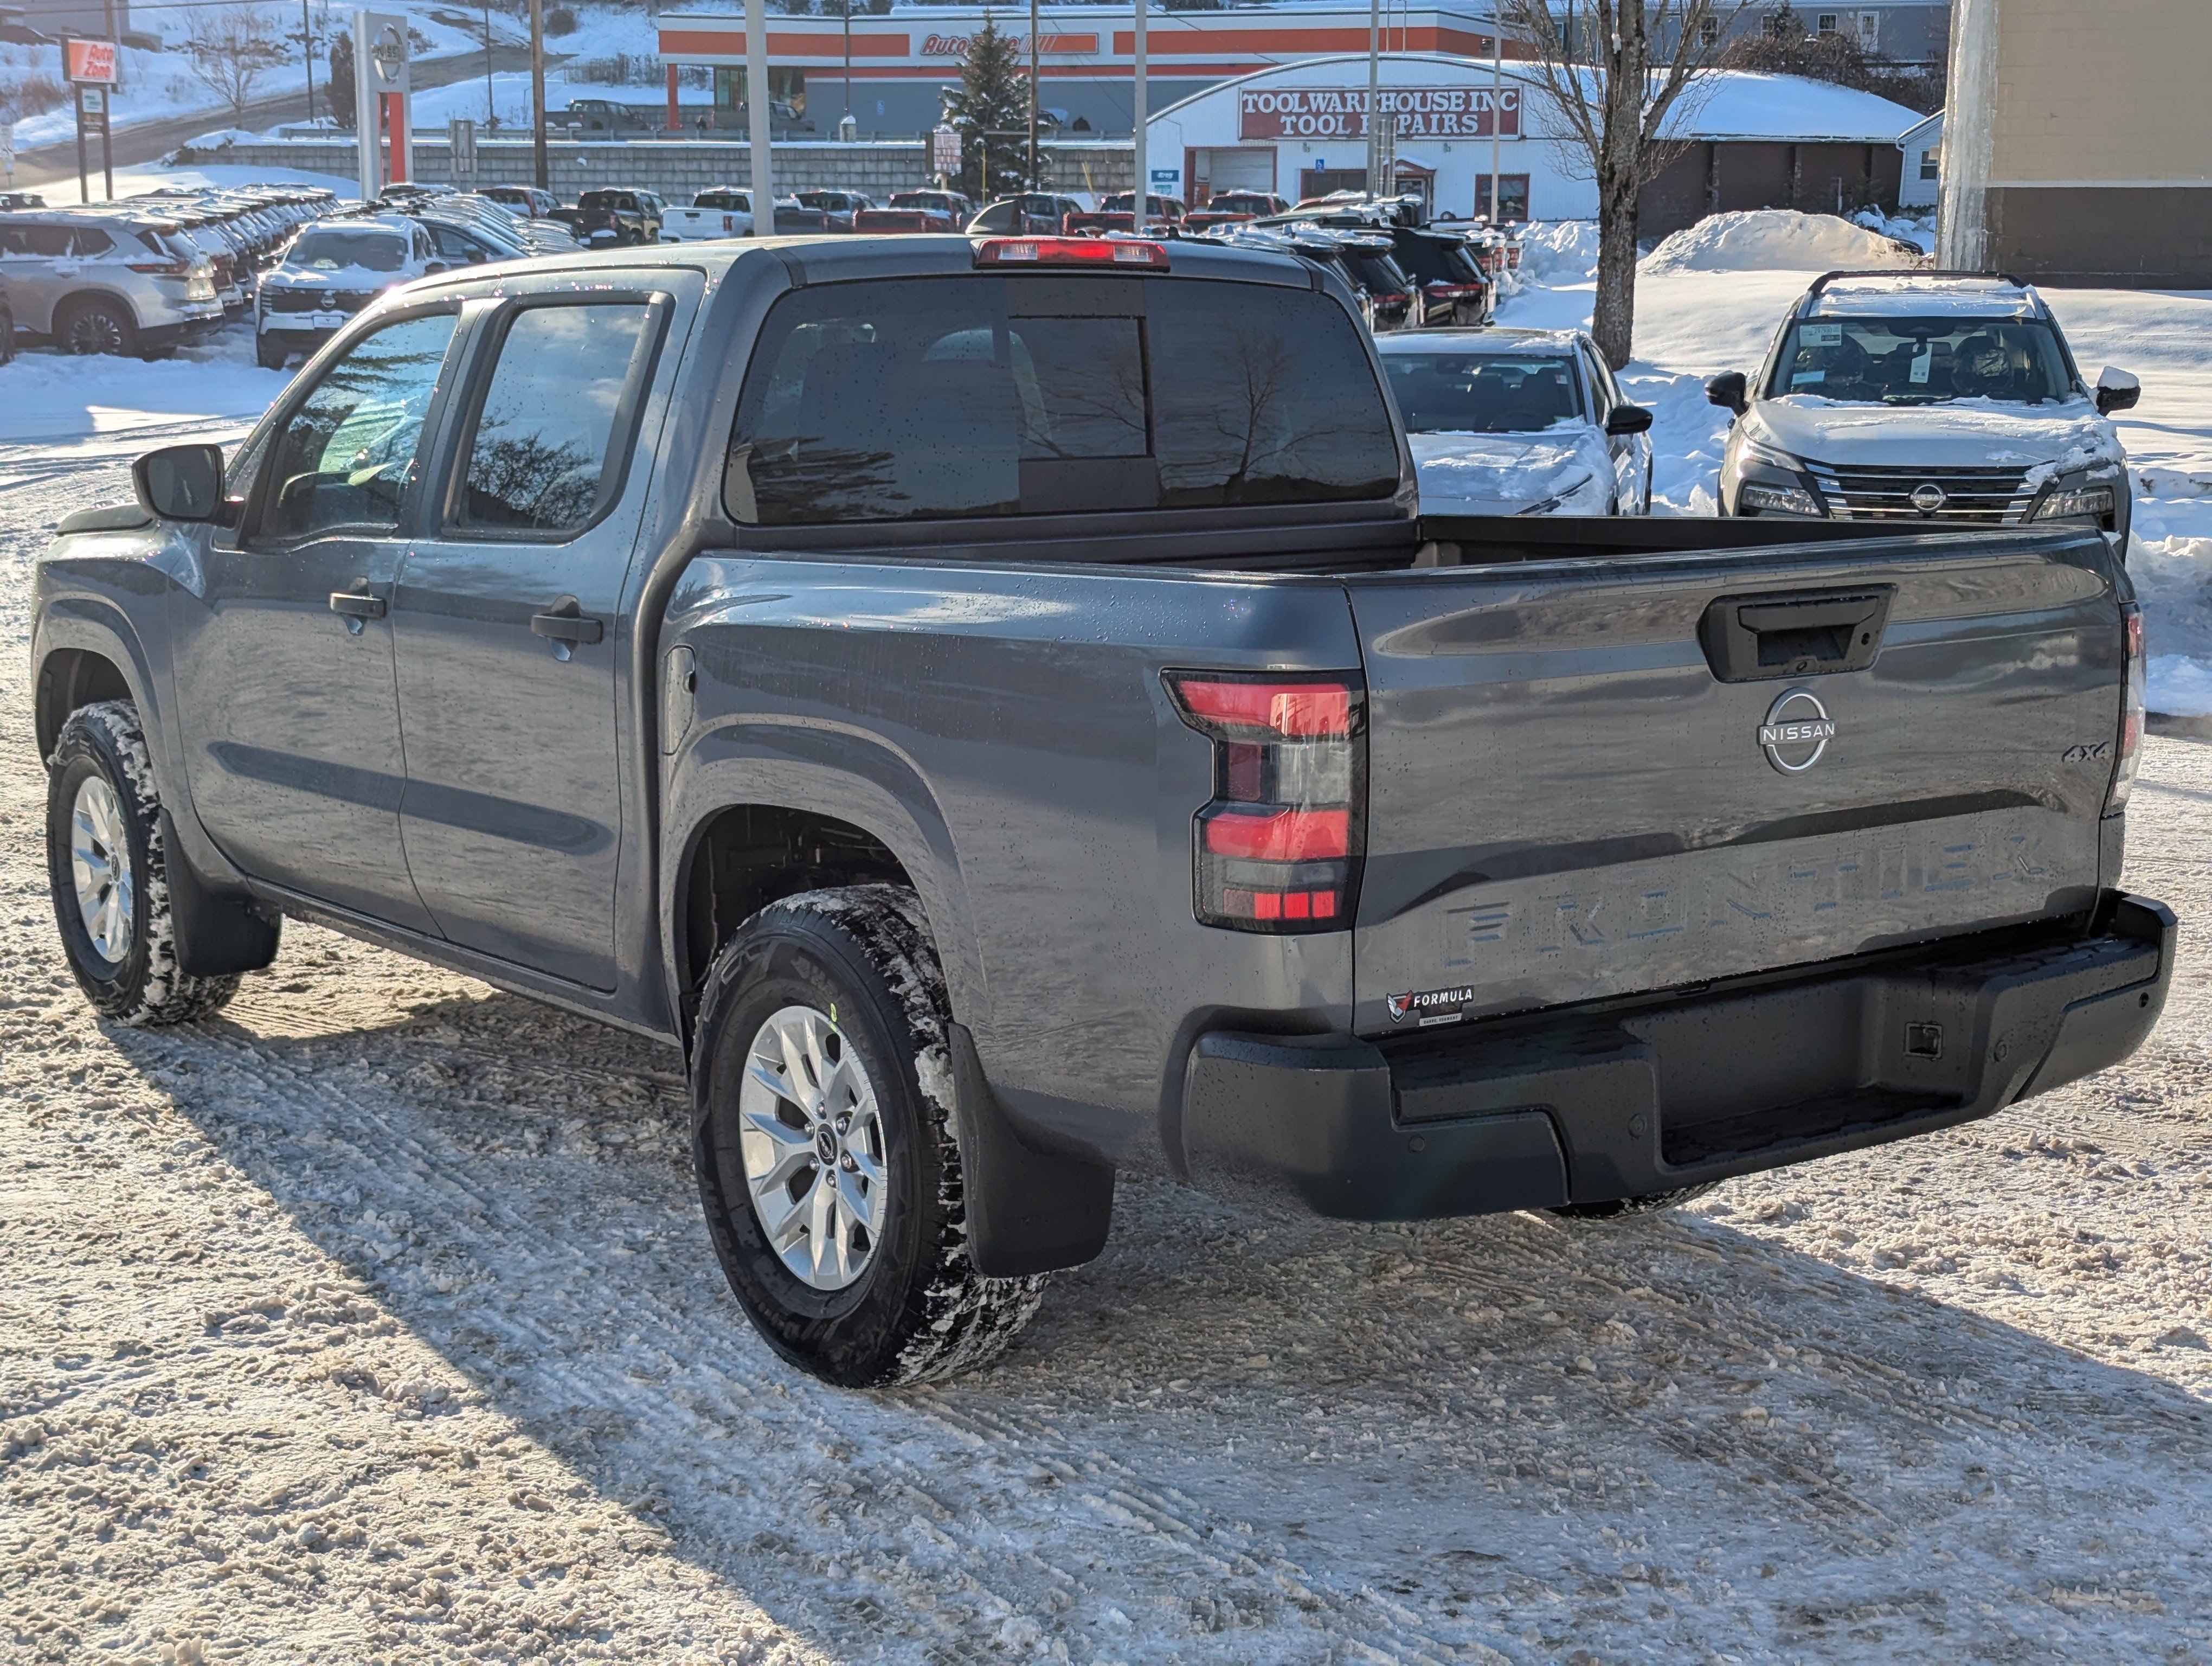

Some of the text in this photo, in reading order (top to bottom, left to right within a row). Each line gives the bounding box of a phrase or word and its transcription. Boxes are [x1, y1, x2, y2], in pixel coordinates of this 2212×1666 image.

[922, 35, 1019, 54] Autoe
[1280, 114, 1478, 134] TOOL PAIRS
[1763, 723, 1835, 741] NISSAN
[1413, 988, 1472, 1007] FORMULA
